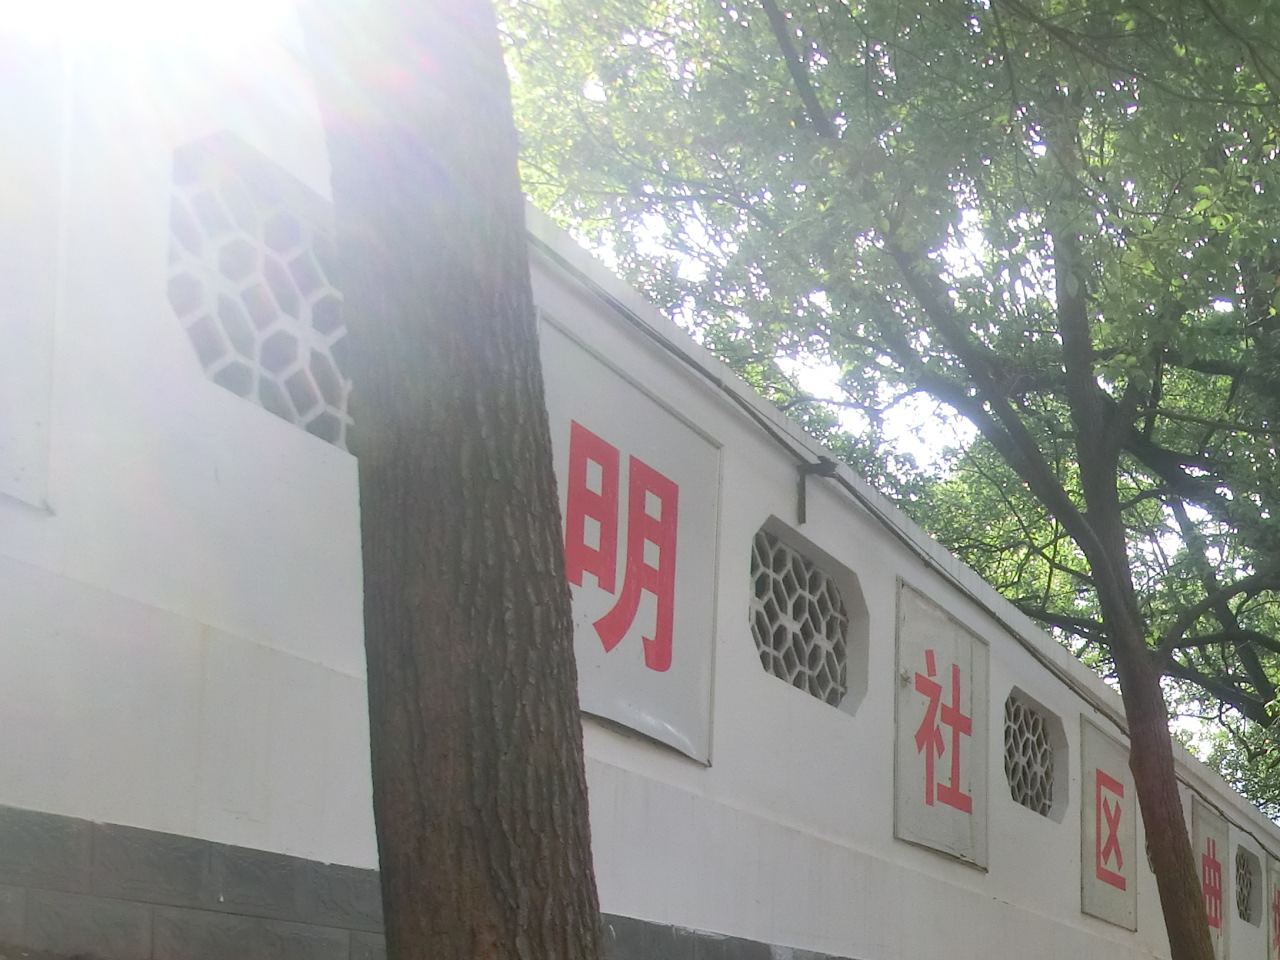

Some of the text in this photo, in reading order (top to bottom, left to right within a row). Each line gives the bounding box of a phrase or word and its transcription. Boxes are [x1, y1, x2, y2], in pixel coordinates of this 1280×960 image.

[564, 420, 679, 673] 明
[914, 650, 973, 815] 社
[1095, 768, 1127, 892] 区
[1201, 837, 1223, 930] 曲
